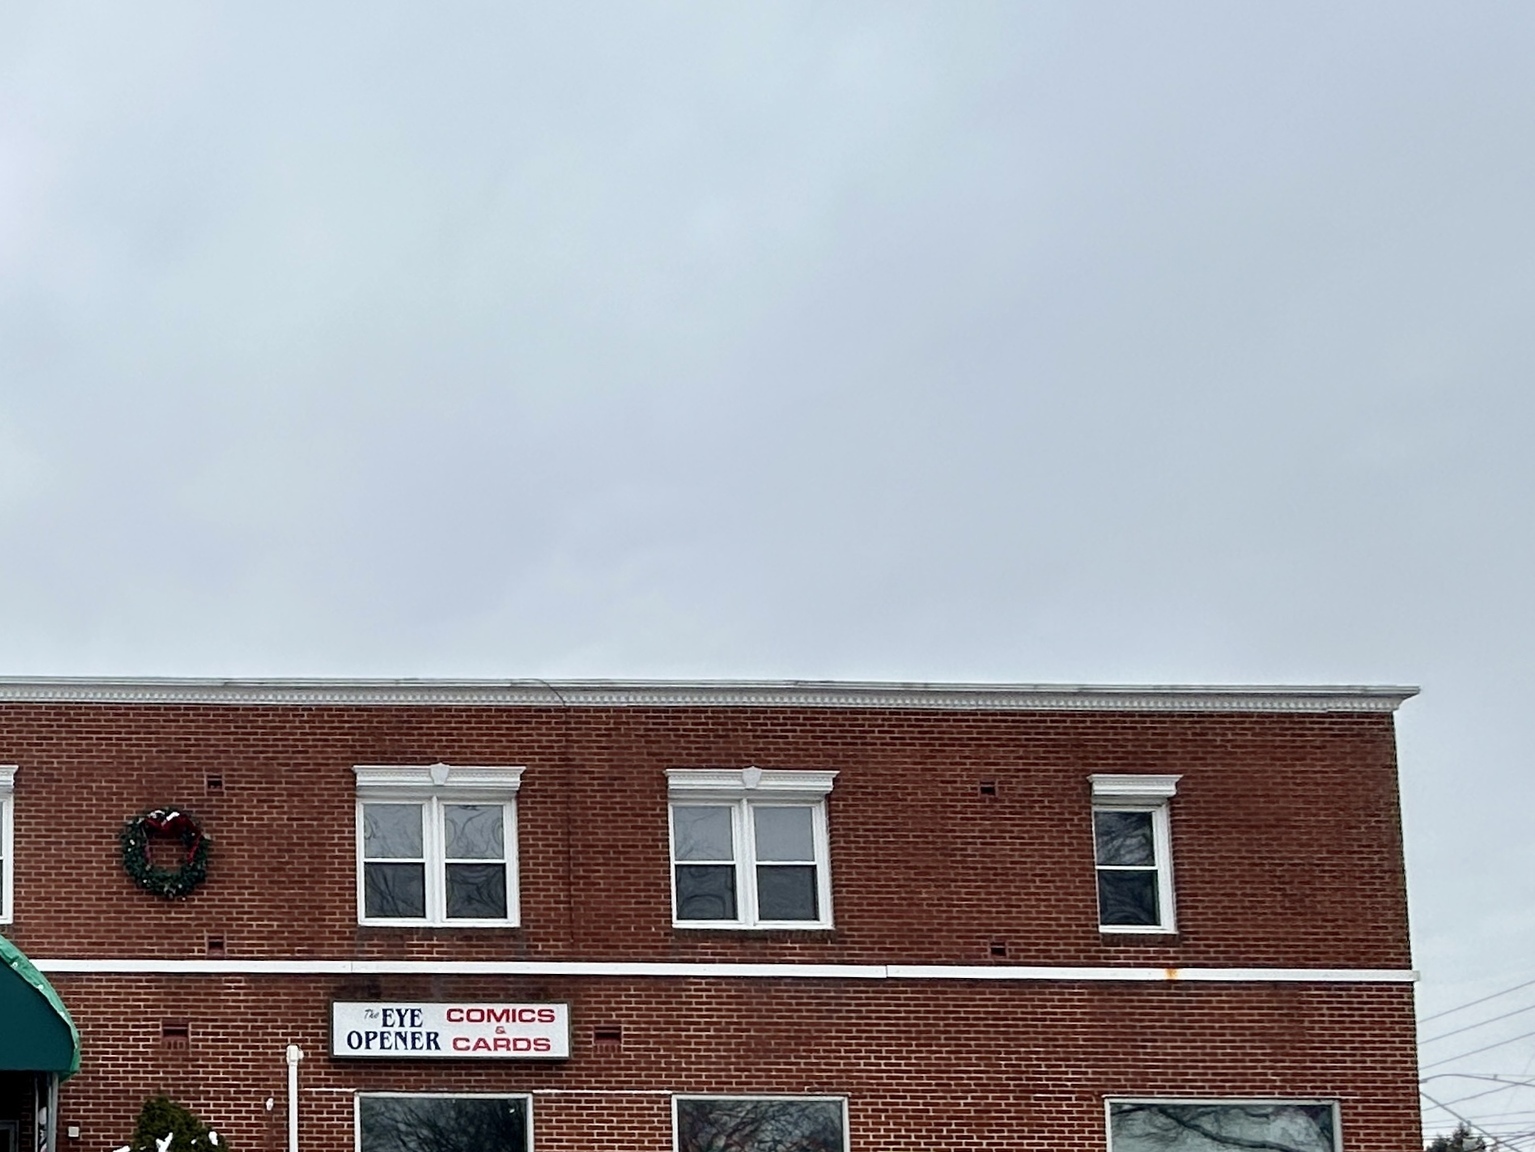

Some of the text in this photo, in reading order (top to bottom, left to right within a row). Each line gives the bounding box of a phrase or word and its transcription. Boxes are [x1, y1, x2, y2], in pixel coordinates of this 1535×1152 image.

[364, 1008, 423, 1028] The EYE
[446, 1008, 556, 1023] COMICS
[495, 1026, 506, 1035] &
[347, 1031, 441, 1050] OPENER
[452, 1037, 552, 1052] CARDS
